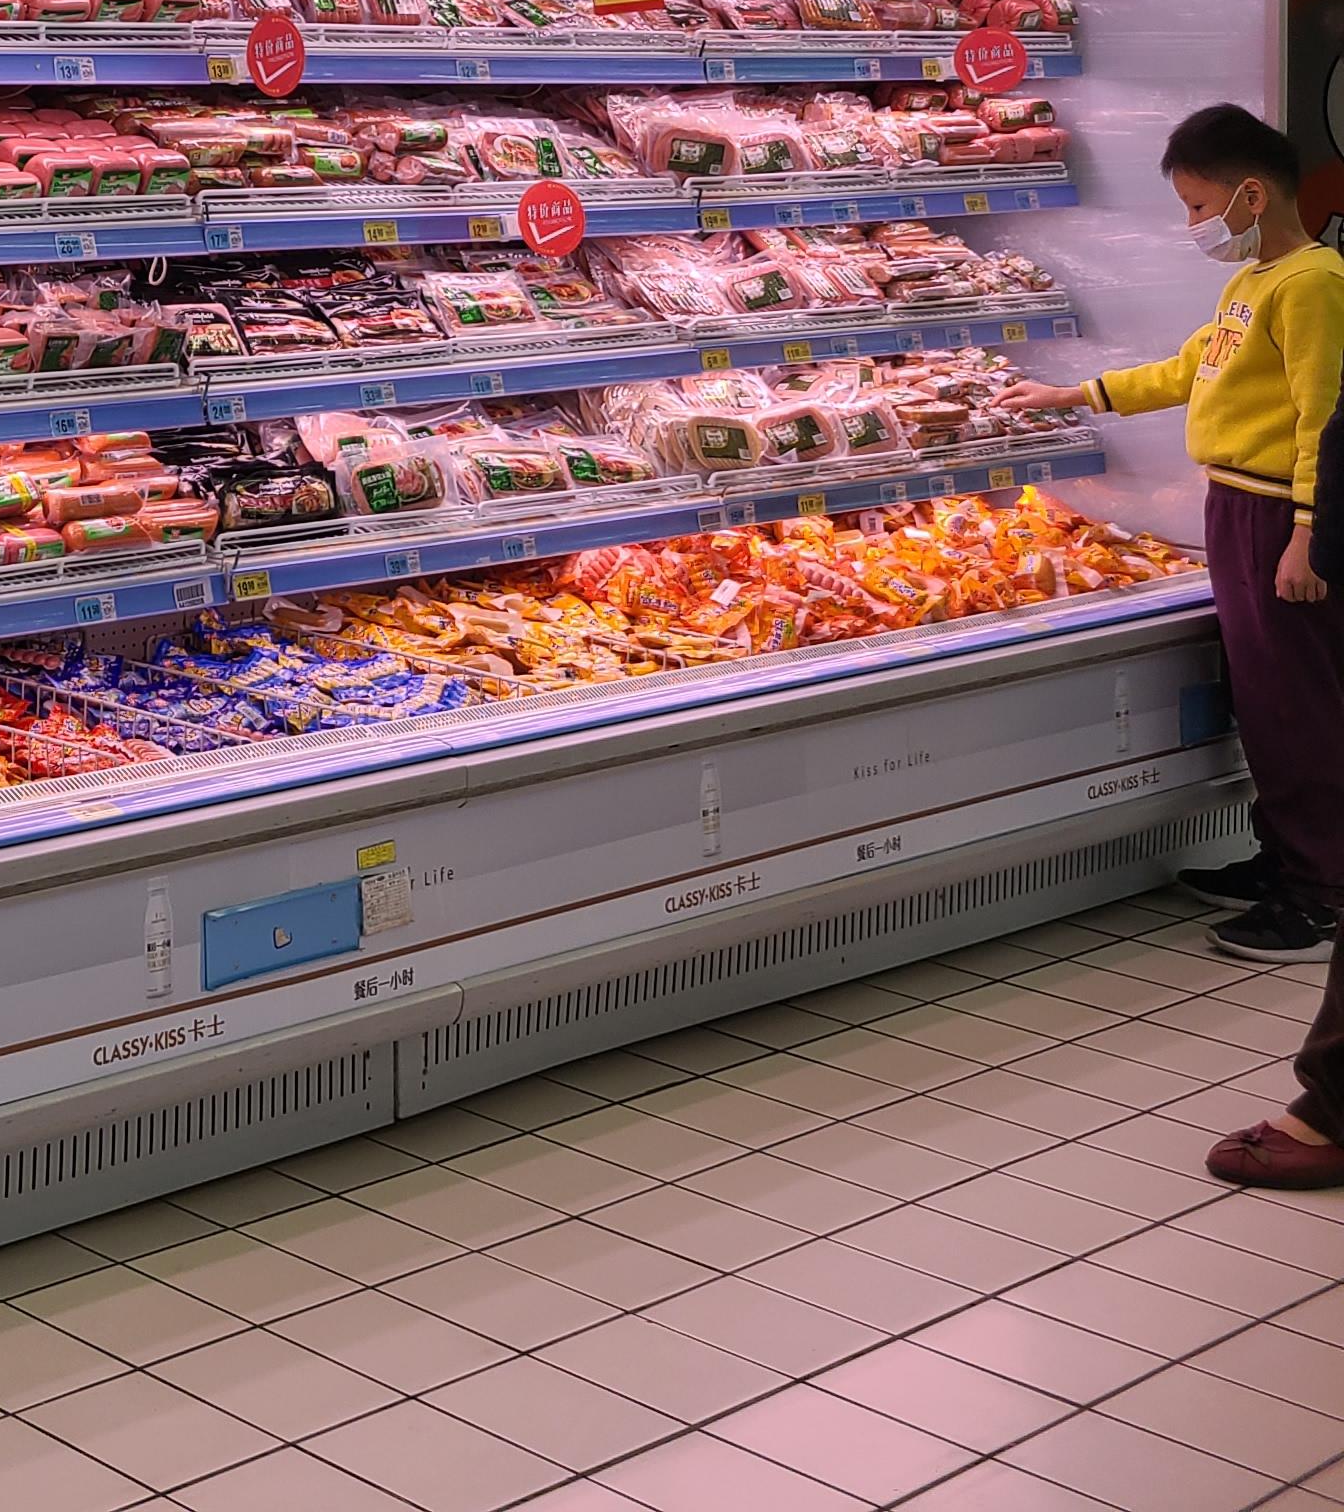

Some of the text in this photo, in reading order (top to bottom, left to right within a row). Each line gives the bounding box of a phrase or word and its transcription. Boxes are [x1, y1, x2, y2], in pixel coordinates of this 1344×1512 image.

[526, 198, 575, 224] 特价商品
[852, 748, 932, 781] Kiss for Life
[1140, 766, 1161, 786] 卡士
[856, 834, 903, 863] 餐后一小时
[424, 865, 455, 887] Life
[733, 870, 762, 894] 卡士
[353, 966, 415, 1001] 餐后一小时
[187, 1013, 226, 1043] 卡士
